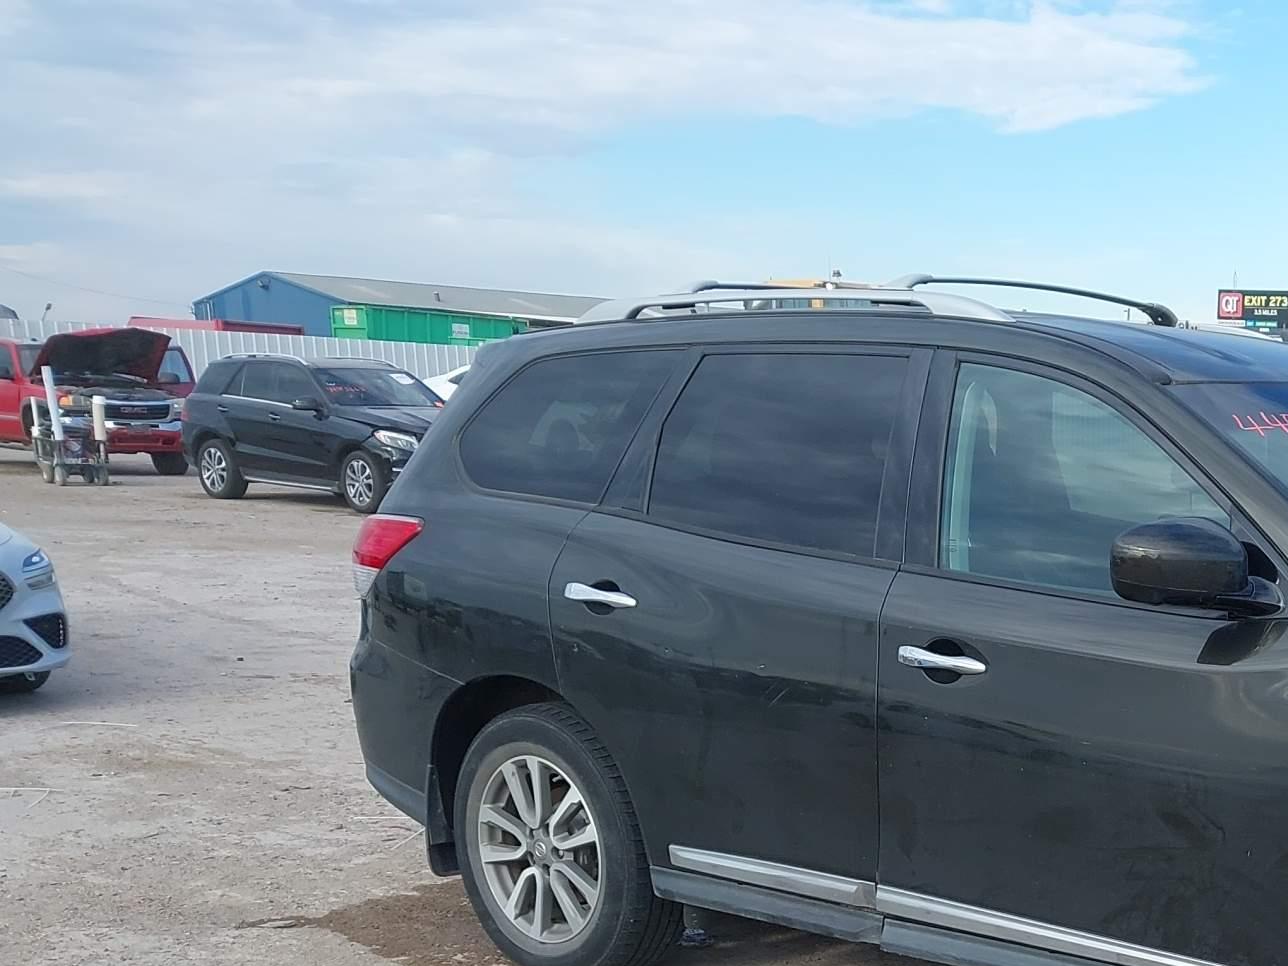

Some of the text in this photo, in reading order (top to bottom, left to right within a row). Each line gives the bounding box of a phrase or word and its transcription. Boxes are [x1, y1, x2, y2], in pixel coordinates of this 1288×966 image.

[1221, 295, 1239, 314] QT
[1244, 295, 1288, 307] EXIT 273
